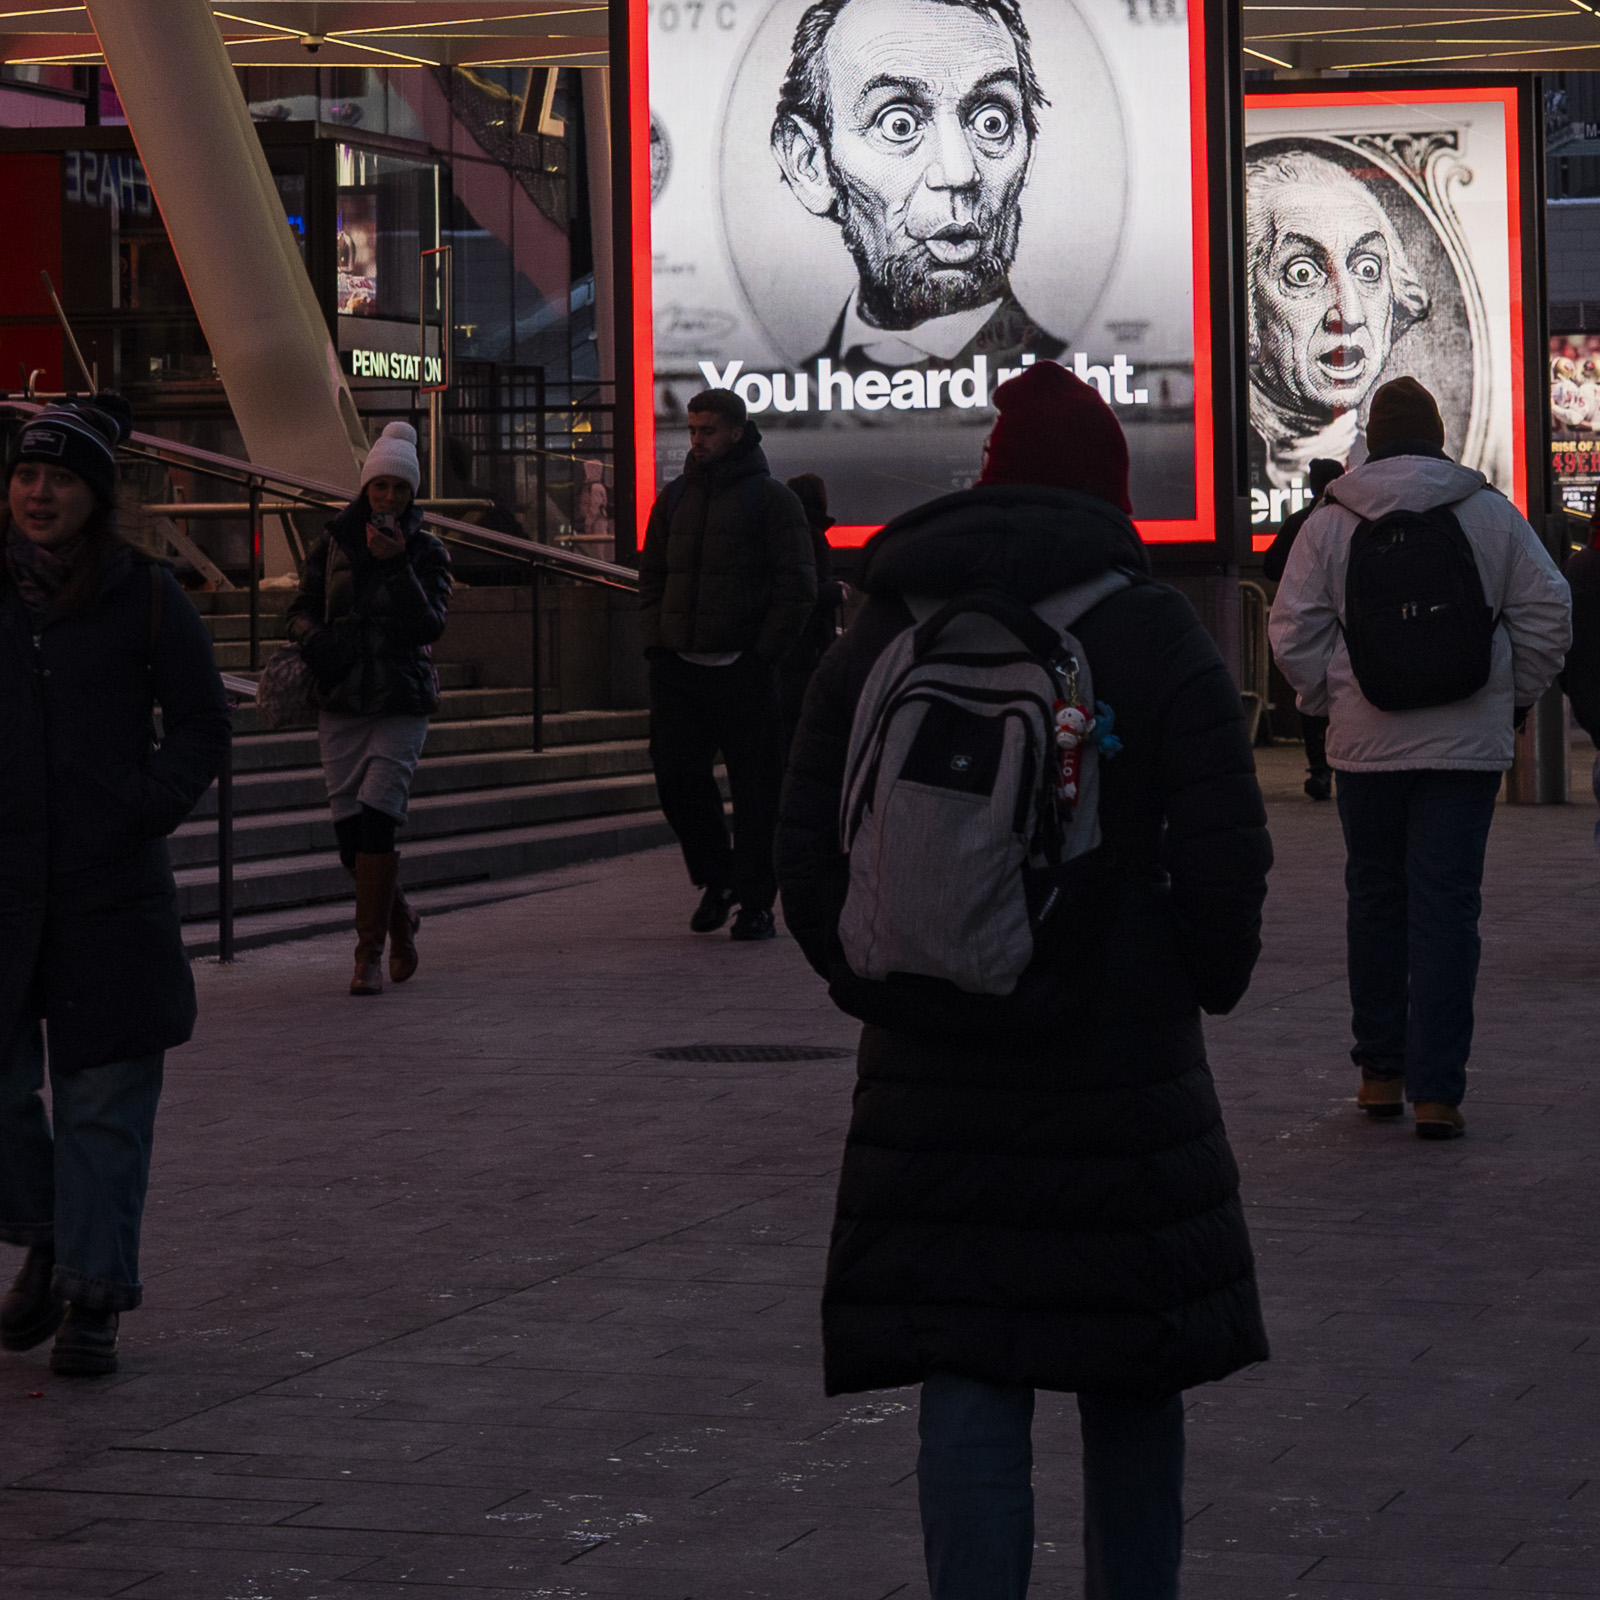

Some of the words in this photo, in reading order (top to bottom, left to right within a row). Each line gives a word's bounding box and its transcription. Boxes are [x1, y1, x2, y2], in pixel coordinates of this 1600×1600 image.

[353, 349, 389, 378] PENN
[391, 352, 441, 382] STATON
[698, 360, 809, 413] You
[817, 355, 988, 411] heard
[1551, 441, 1577, 453] RISE
[1578, 441, 1593, 452] OF
